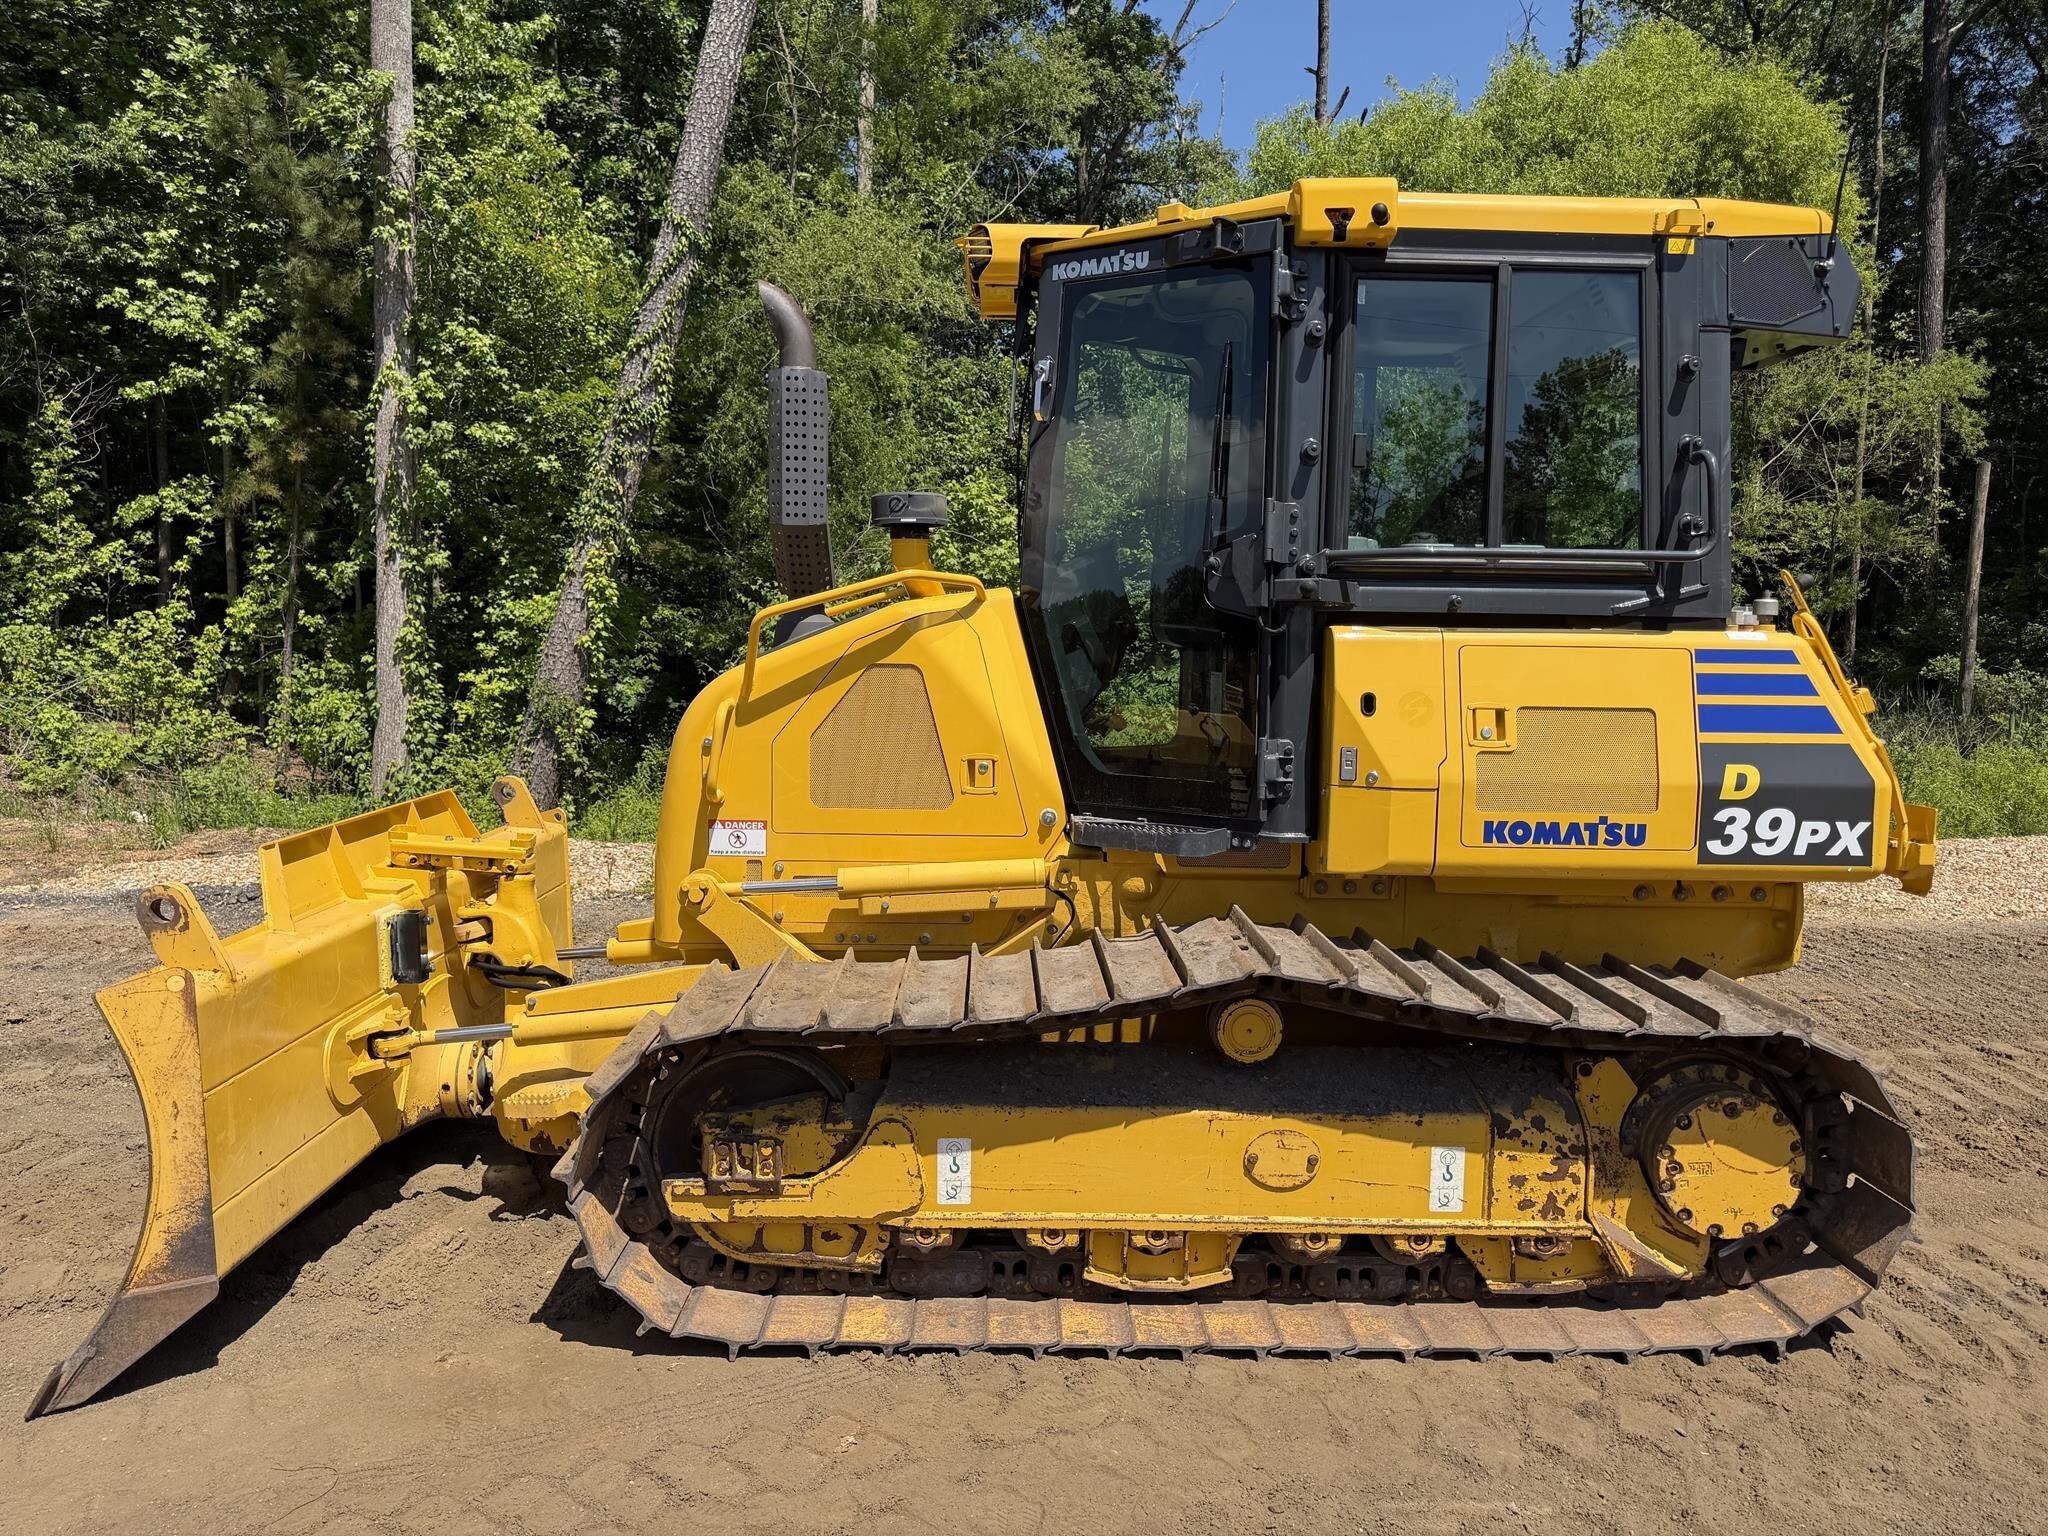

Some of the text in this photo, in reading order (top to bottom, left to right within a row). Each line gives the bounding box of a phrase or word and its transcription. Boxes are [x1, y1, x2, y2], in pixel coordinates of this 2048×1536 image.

[1052, 250, 1150, 281] KOMATSU
[1719, 764, 1760, 800] D
[724, 822, 764, 830] DANGER
[1482, 816, 1647, 847] KOMATSU
[1705, 807, 1871, 857] 39PX
